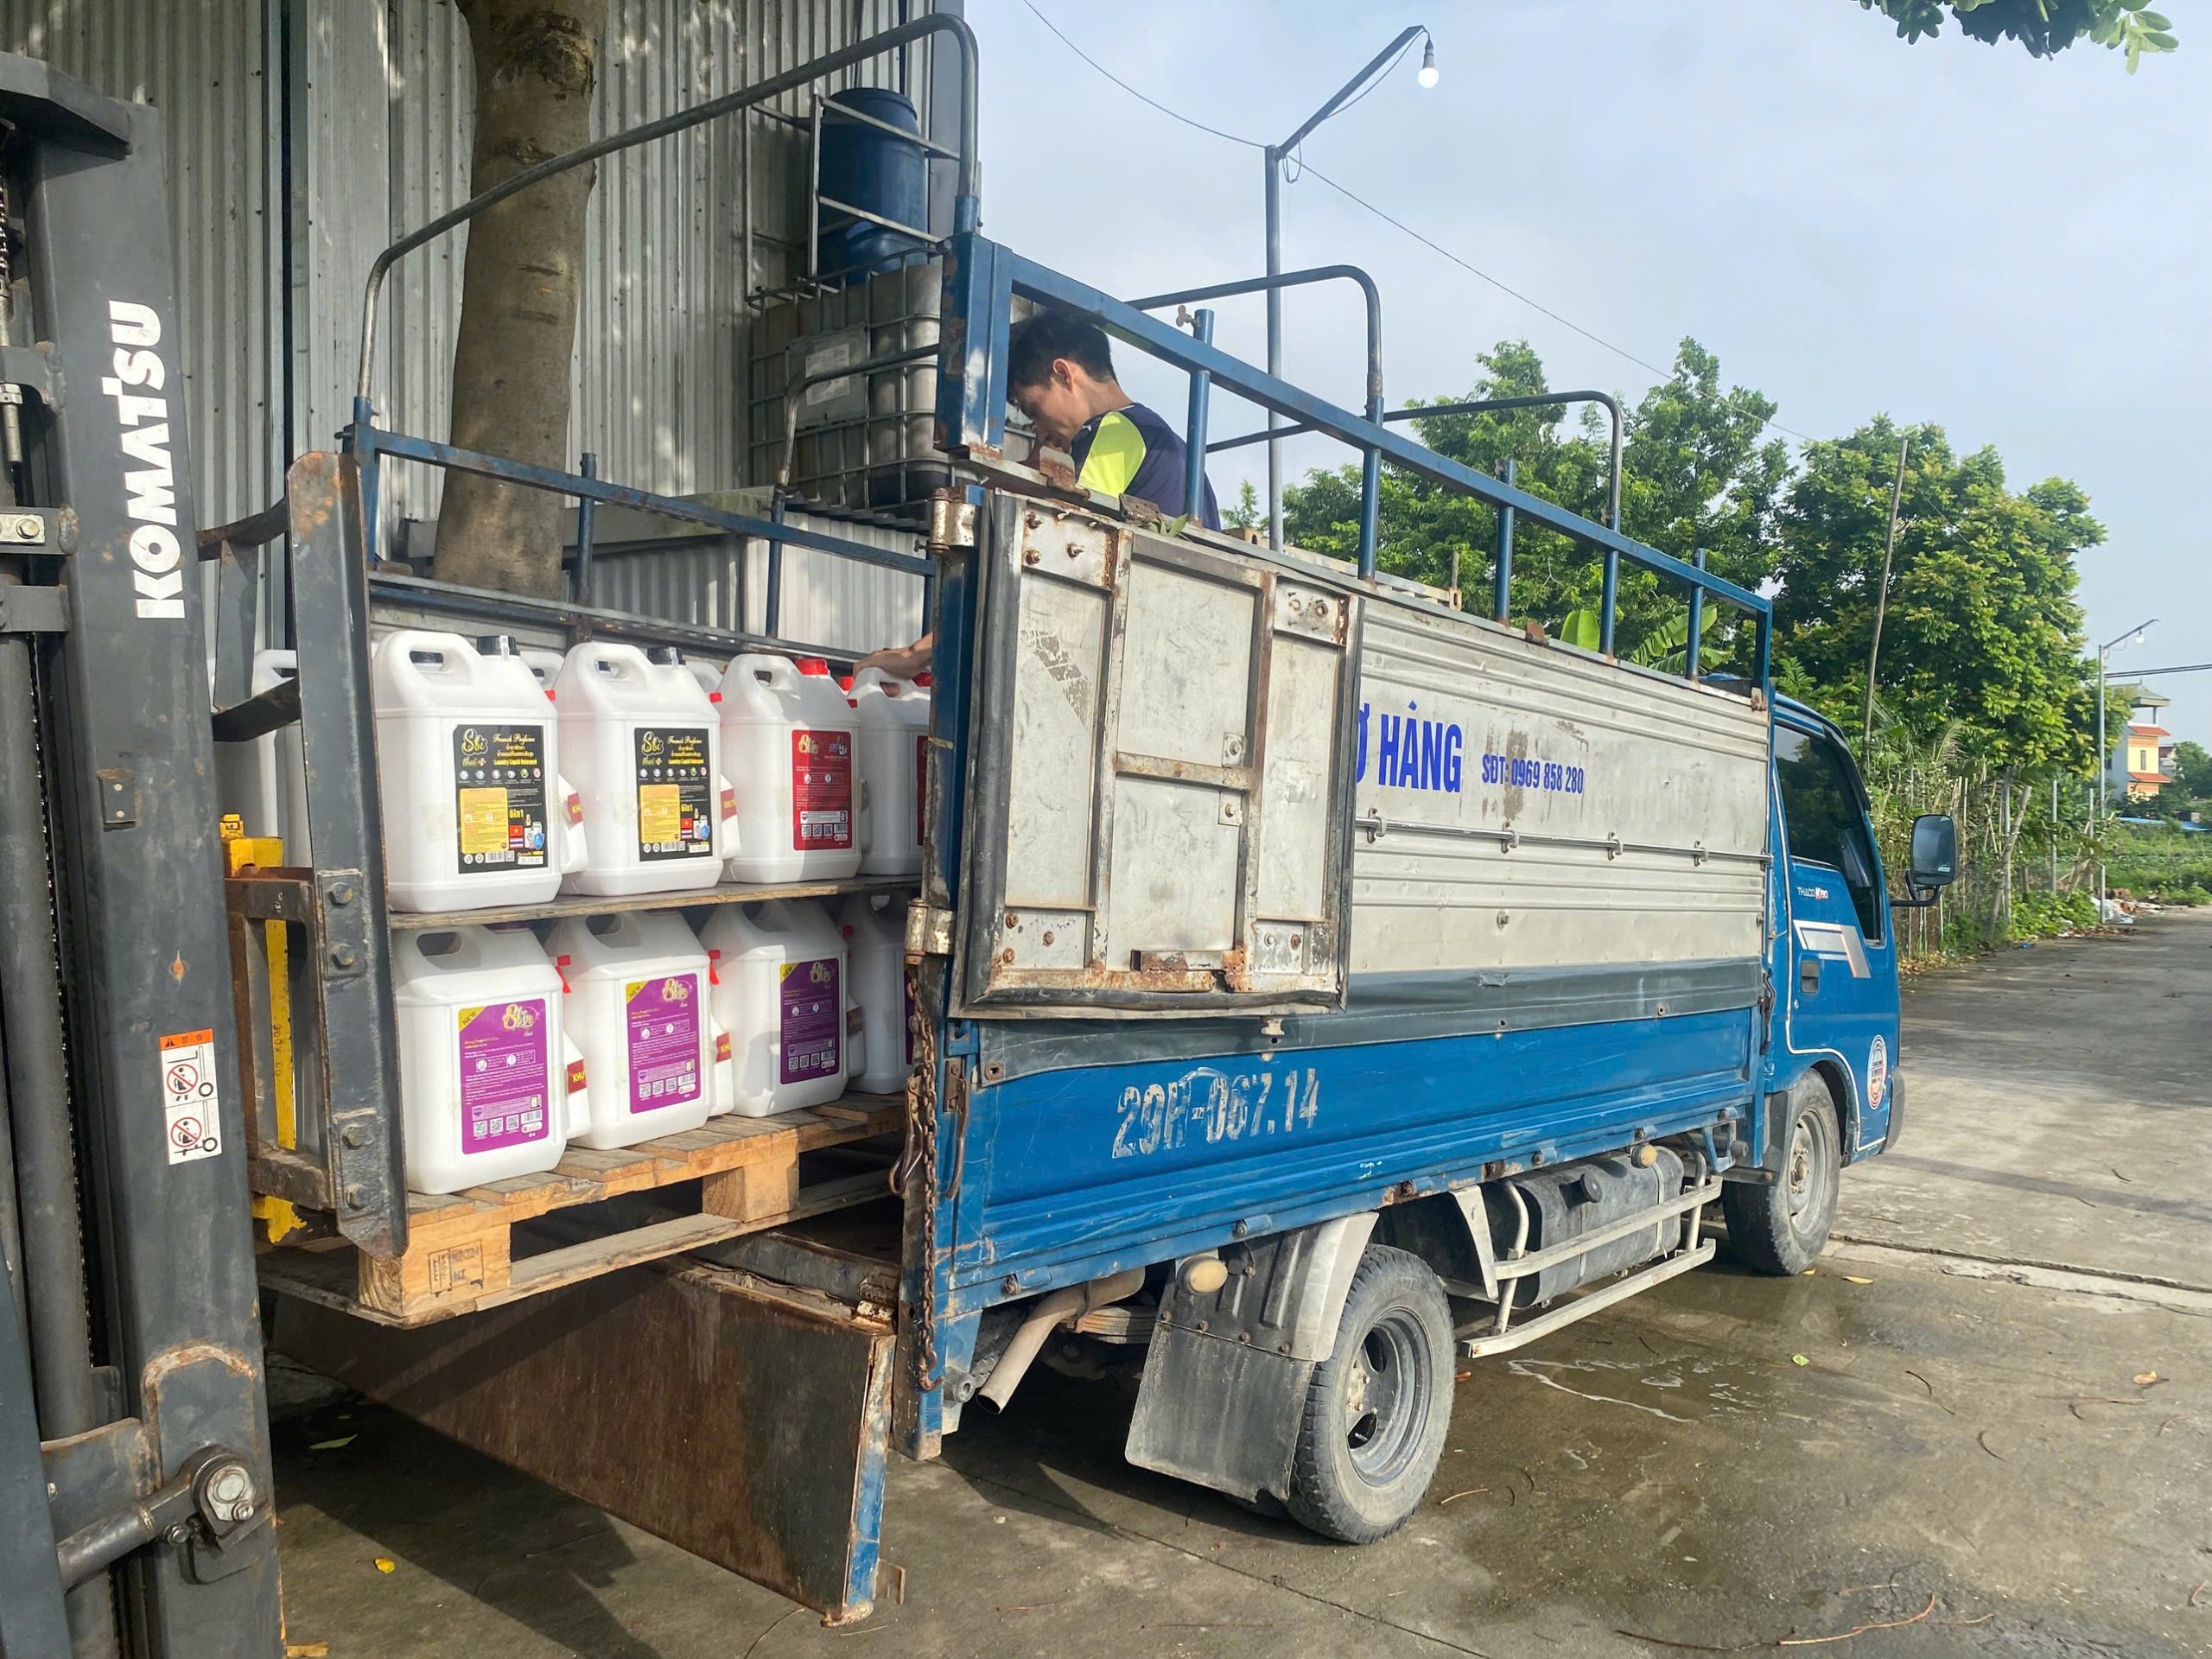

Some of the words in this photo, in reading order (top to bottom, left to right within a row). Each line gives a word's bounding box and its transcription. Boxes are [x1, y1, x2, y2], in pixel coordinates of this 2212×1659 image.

[102, 300, 185, 620] KOMATSU
[1510, 758, 1540, 788] 0969
[1543, 762, 1562, 791] 858
[1565, 766, 1584, 794] 280
[509, 809, 524, 818] 6in1
[462, 1010, 477, 1026] NEW
